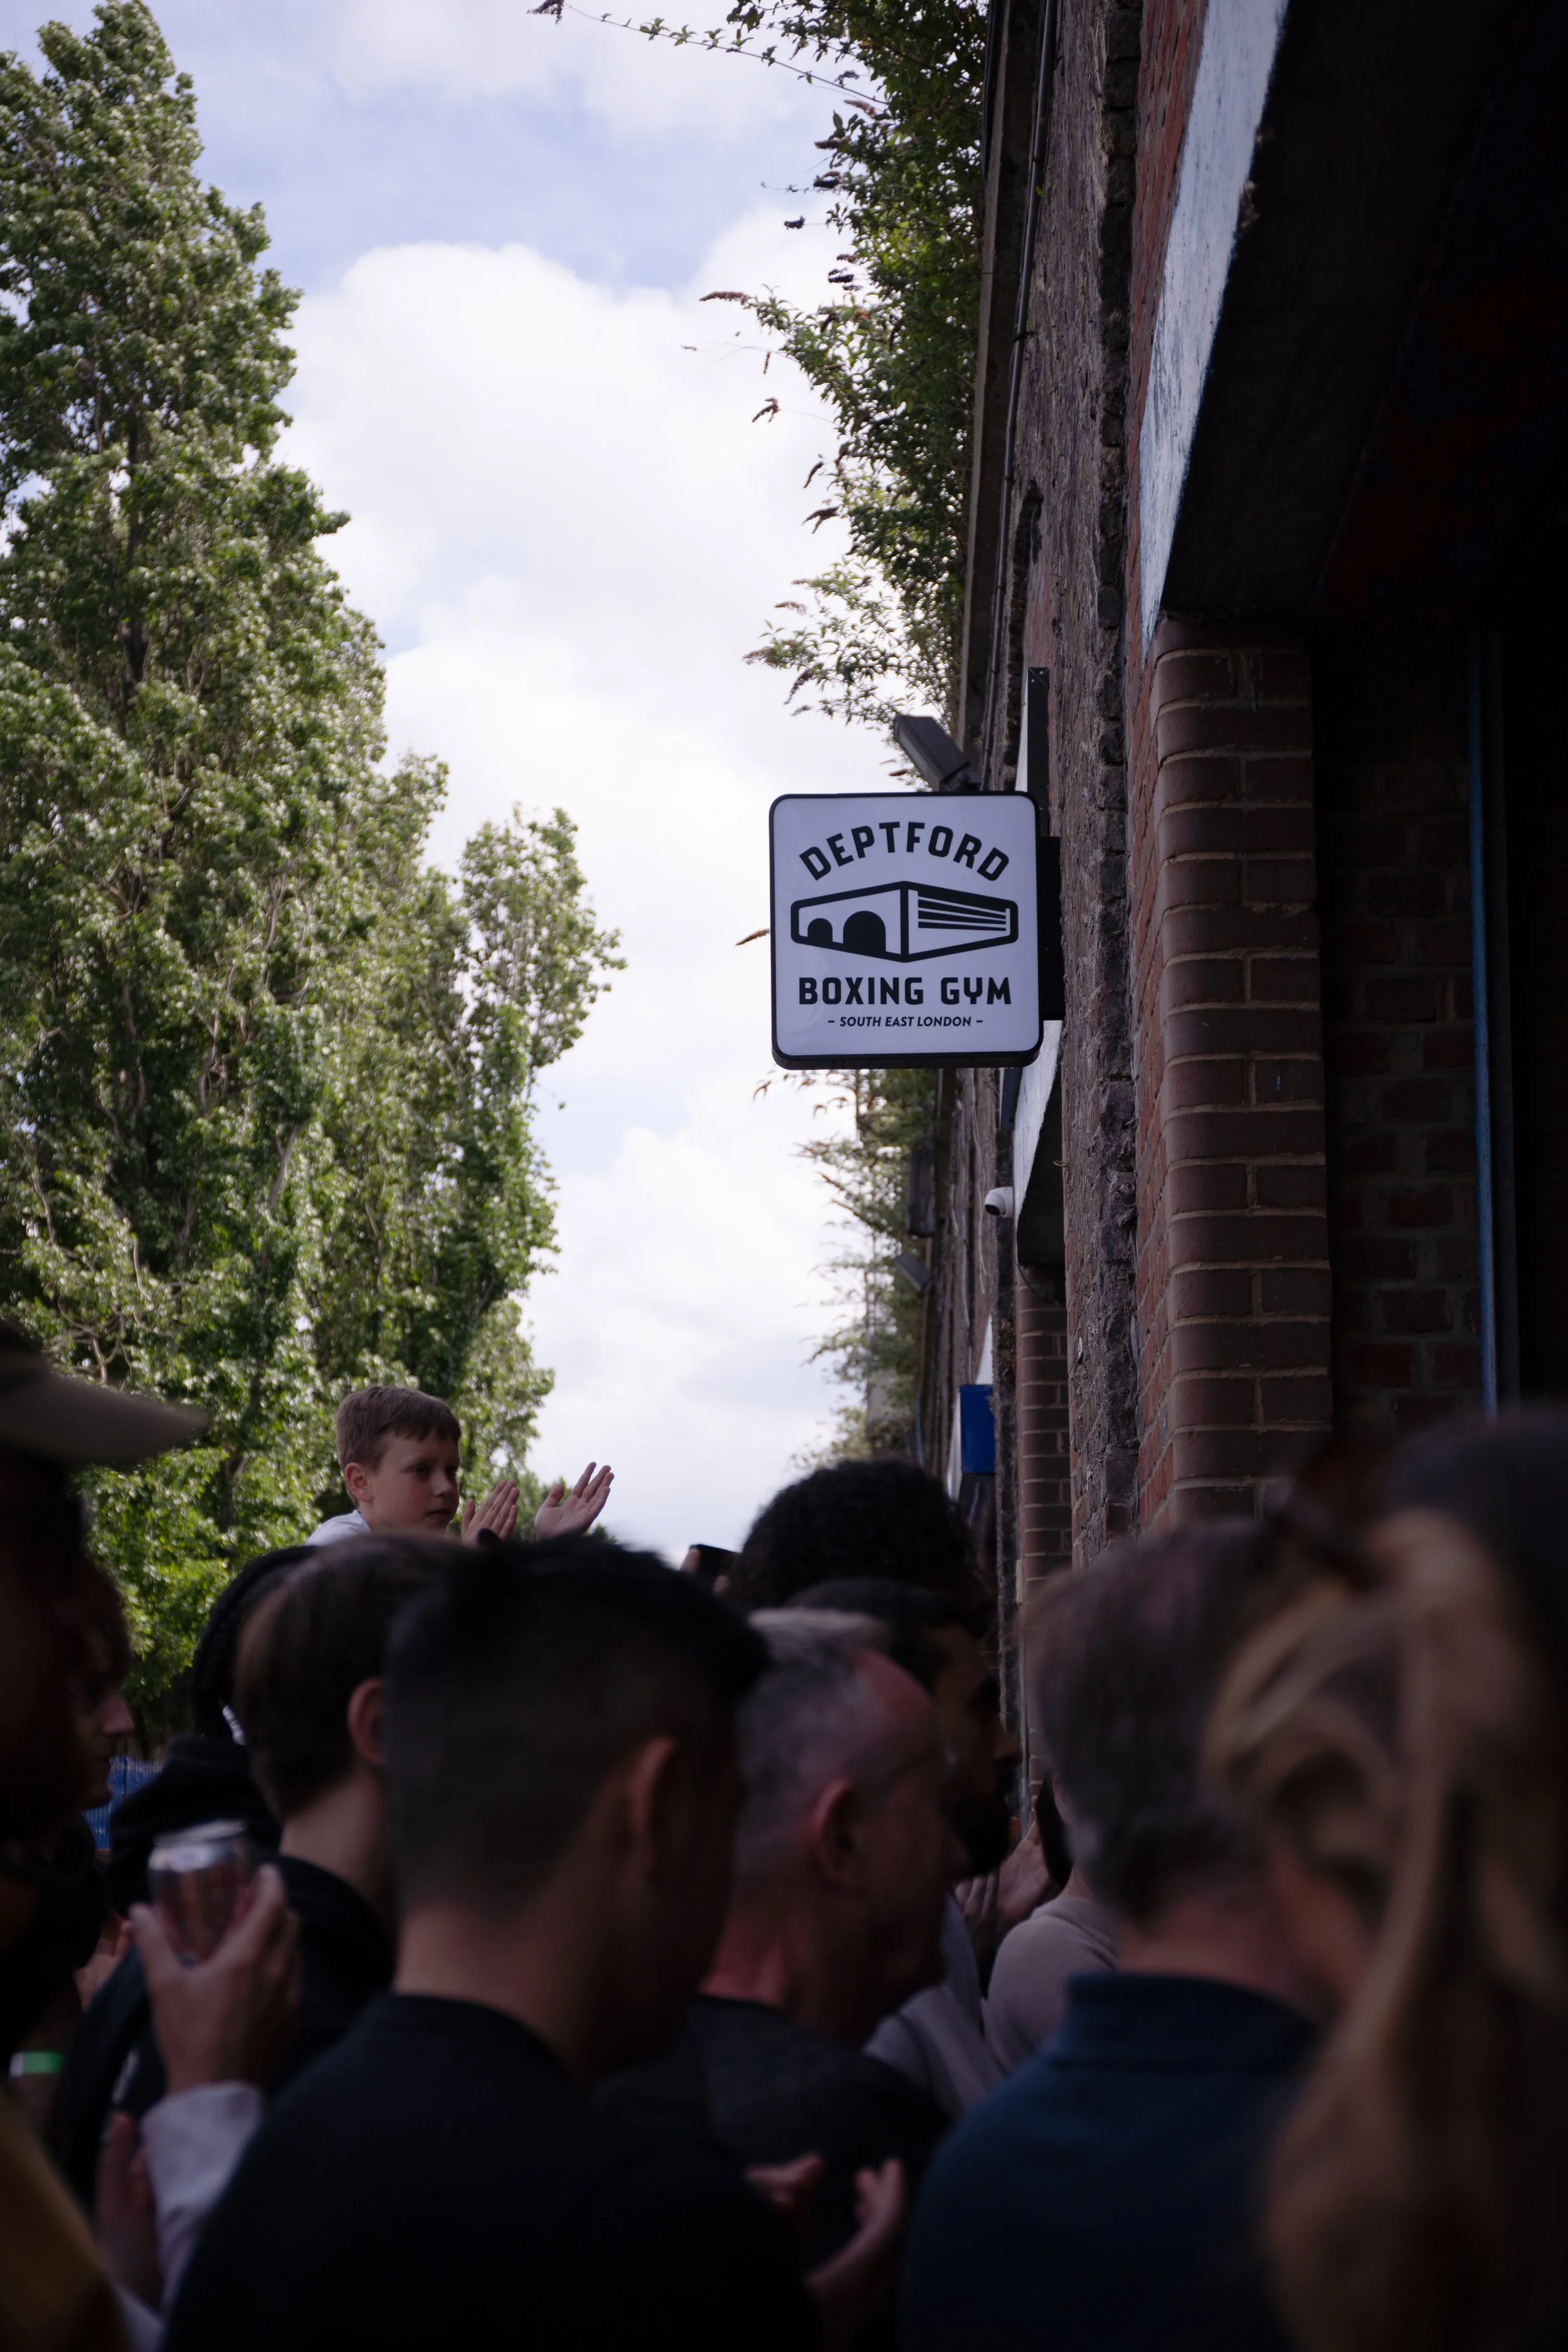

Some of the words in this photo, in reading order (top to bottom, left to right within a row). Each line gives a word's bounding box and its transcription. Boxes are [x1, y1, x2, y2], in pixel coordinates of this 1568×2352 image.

[798, 821, 1010, 882] DEPTFORD
[798, 977, 924, 1005] BOXING
[940, 977, 1012, 1005] GYM
[839, 1016, 882, 1027] SOUTH
[884, 1016, 915, 1027] EAST
[917, 1016, 972, 1027] LONDON
